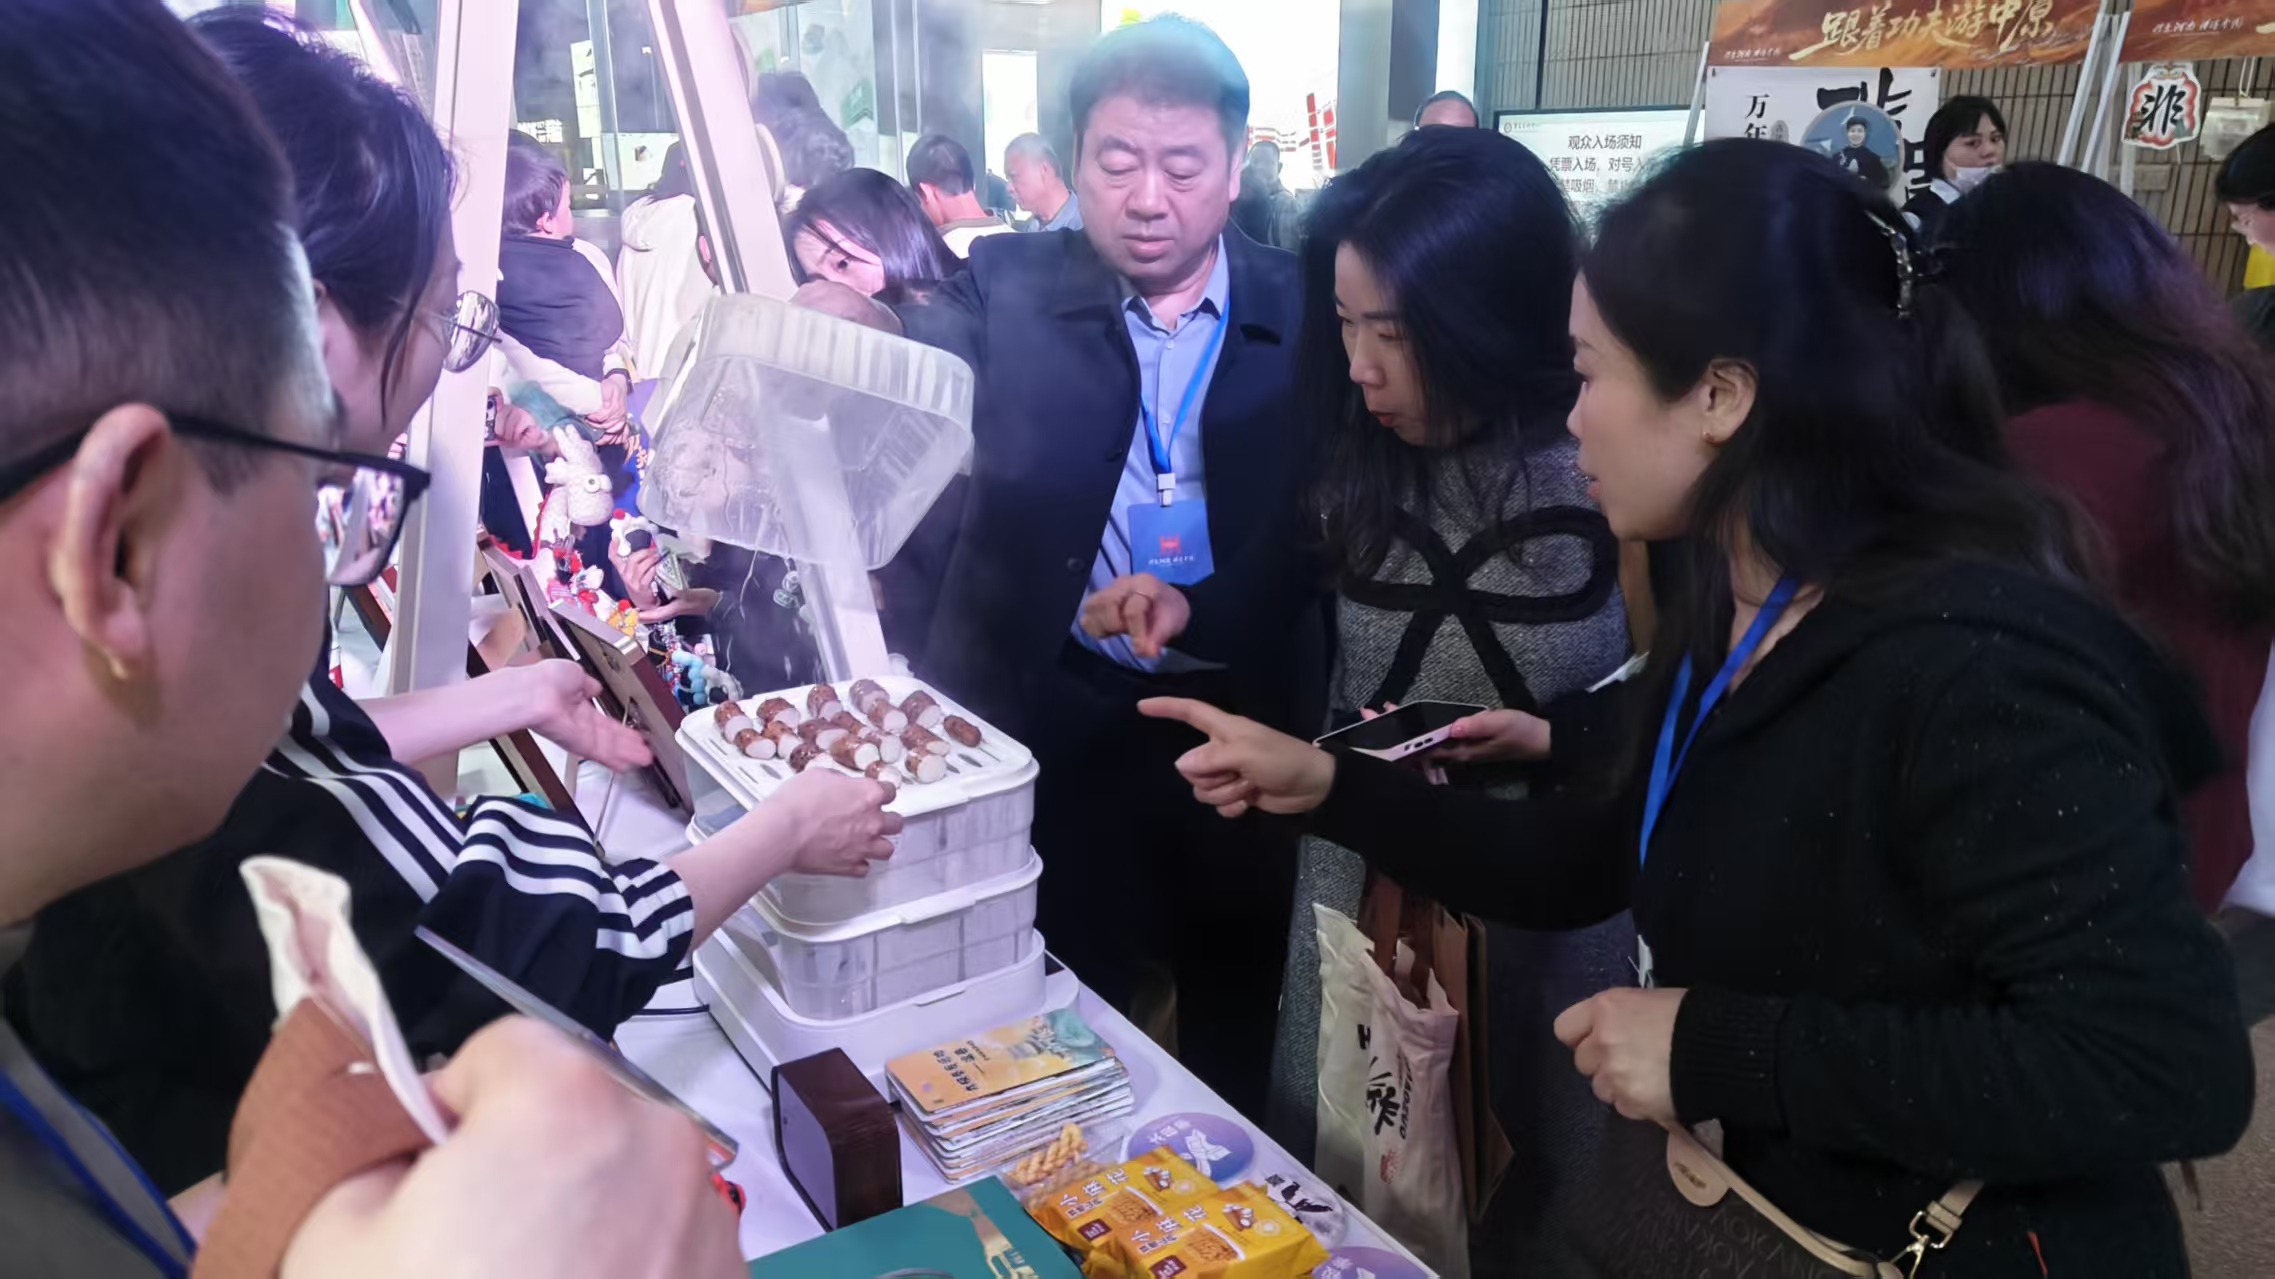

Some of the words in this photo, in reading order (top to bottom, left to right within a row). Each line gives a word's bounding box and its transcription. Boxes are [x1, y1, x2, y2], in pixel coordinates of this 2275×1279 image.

[1789, 0, 2054, 61] 跟着功夫游中原
[1568, 135, 1642, 151] 观众入场须知
